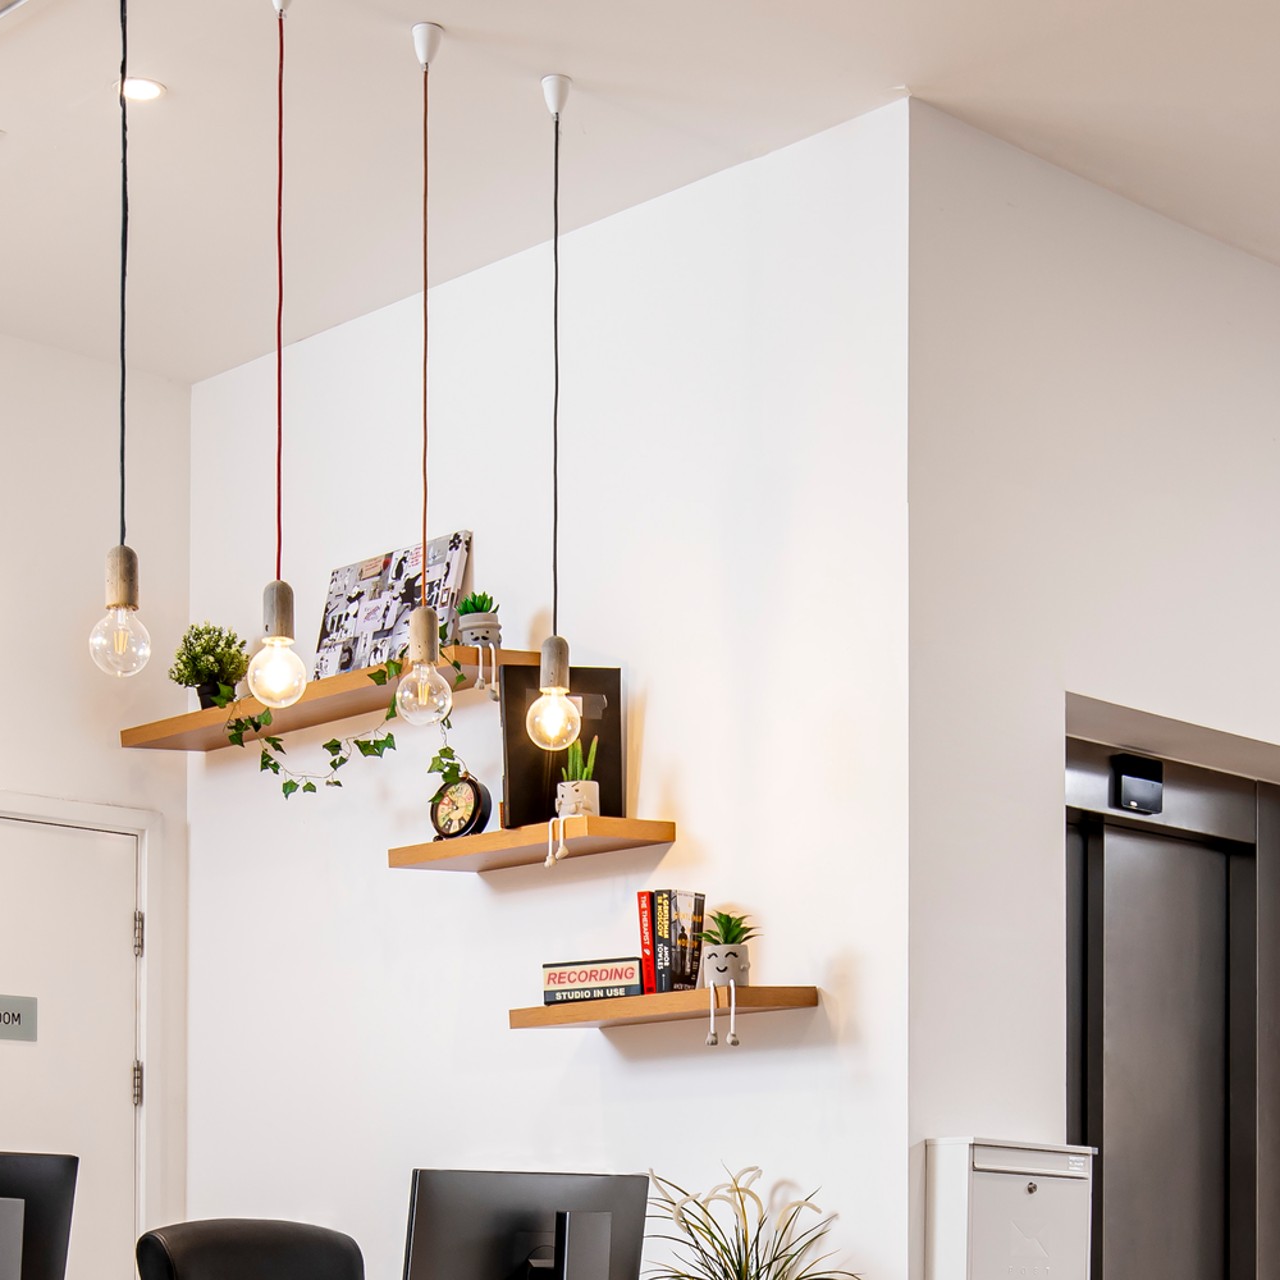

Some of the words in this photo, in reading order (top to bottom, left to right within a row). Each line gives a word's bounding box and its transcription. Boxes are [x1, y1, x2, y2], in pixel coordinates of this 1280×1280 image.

[640, 896, 648, 909] THE
[641, 910, 650, 945] THERAPIST
[547, 966, 635, 985] RECORDING
[555, 990, 591, 1000] STUDIO
[593, 989, 604, 998] IN
[606, 987, 626, 997] USE
